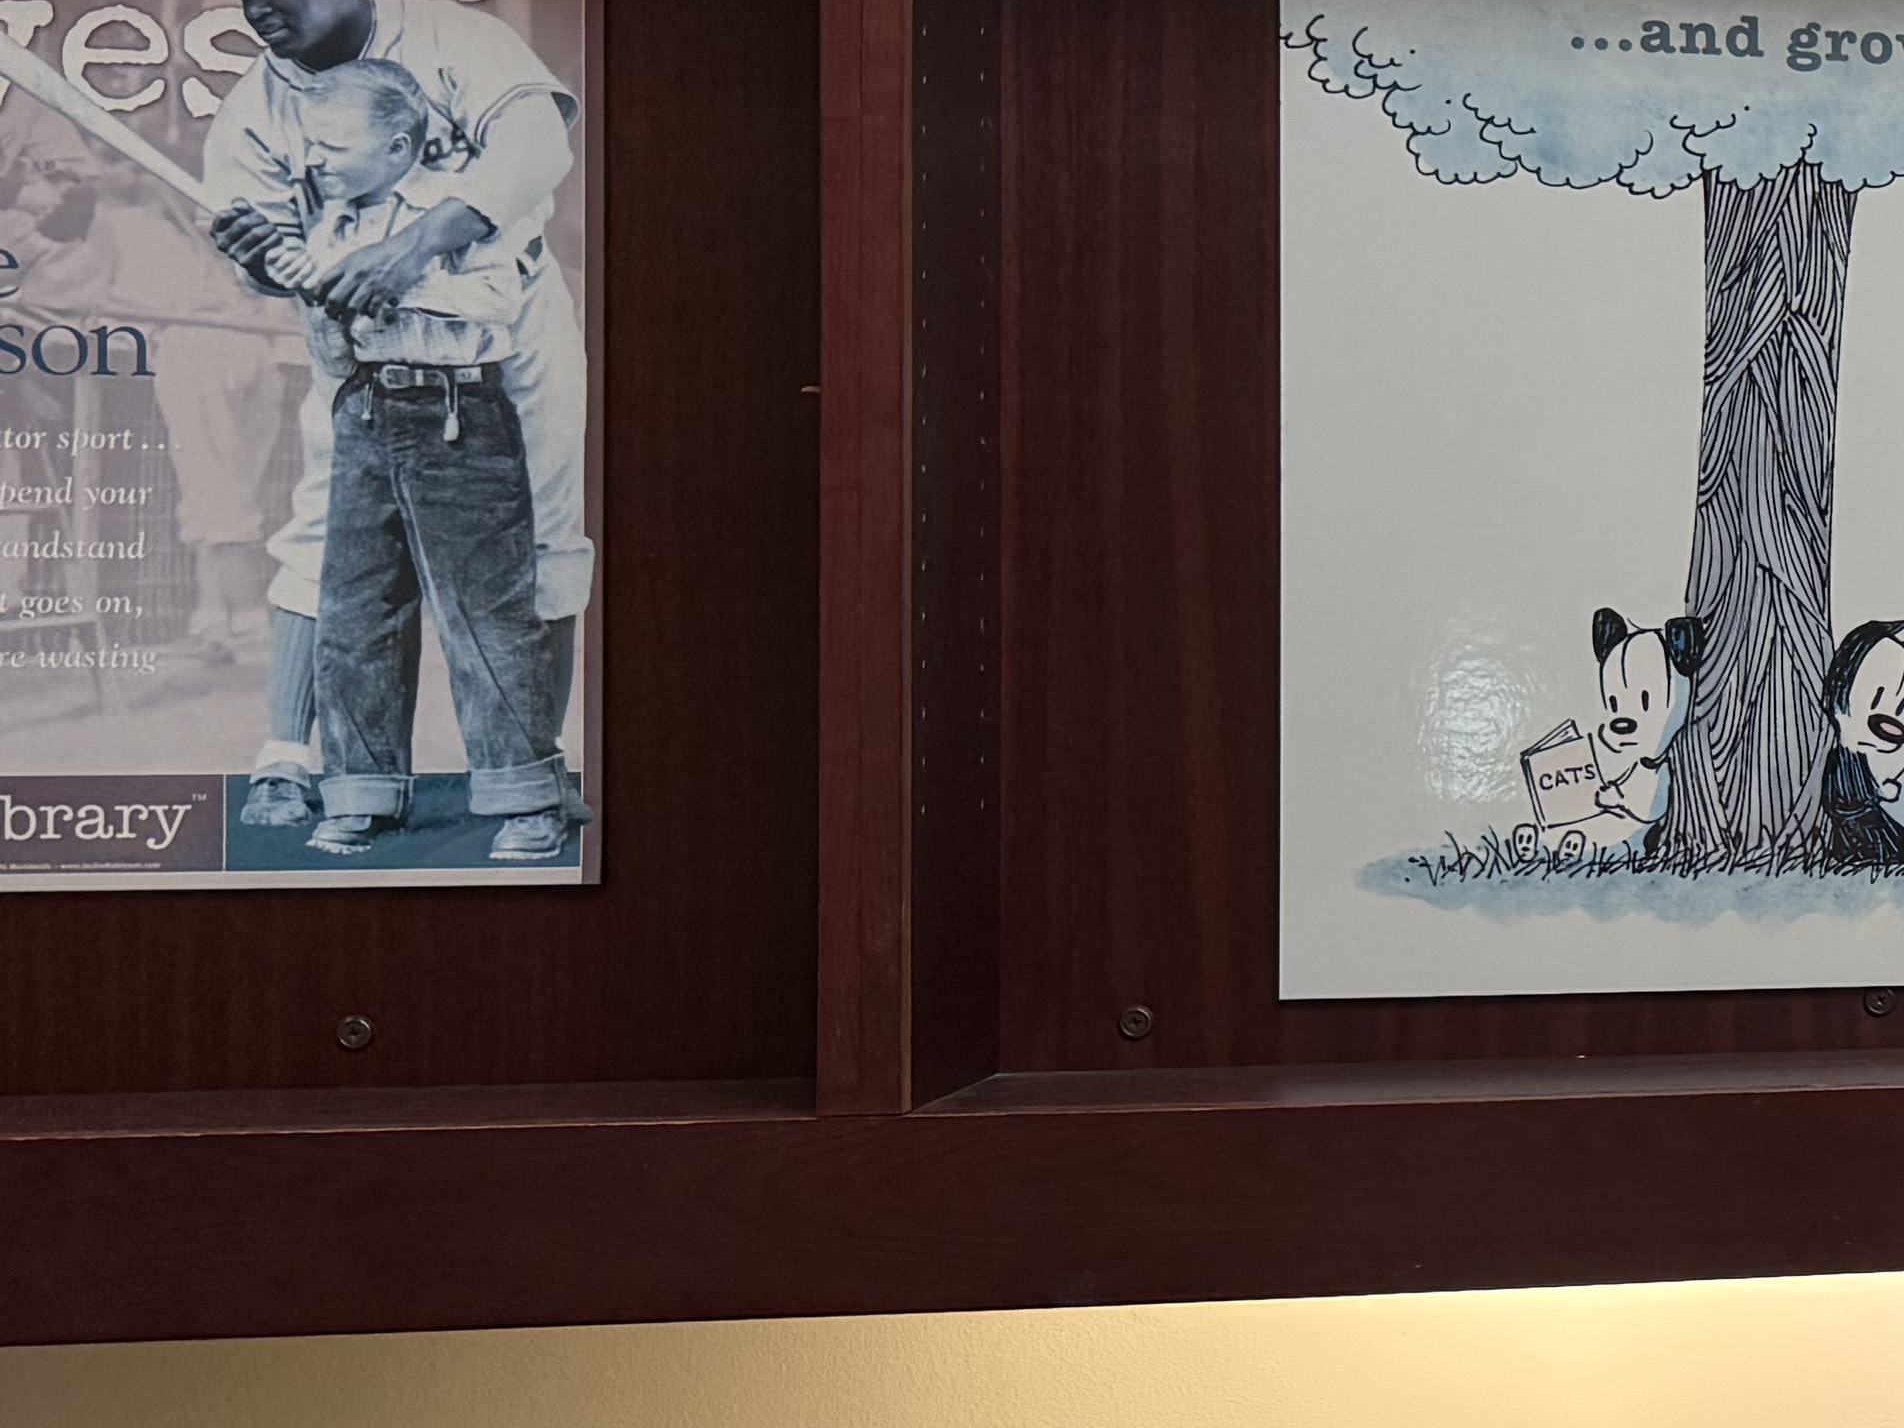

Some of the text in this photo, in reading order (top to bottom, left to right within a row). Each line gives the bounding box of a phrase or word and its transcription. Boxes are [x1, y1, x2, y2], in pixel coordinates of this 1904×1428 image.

[83, 487, 152, 508] your
[3, 531, 146, 559] andstand
[20, 597, 83, 619] goes
[38, 643, 156, 673] wasting
[1538, 765, 1597, 795] CATS
